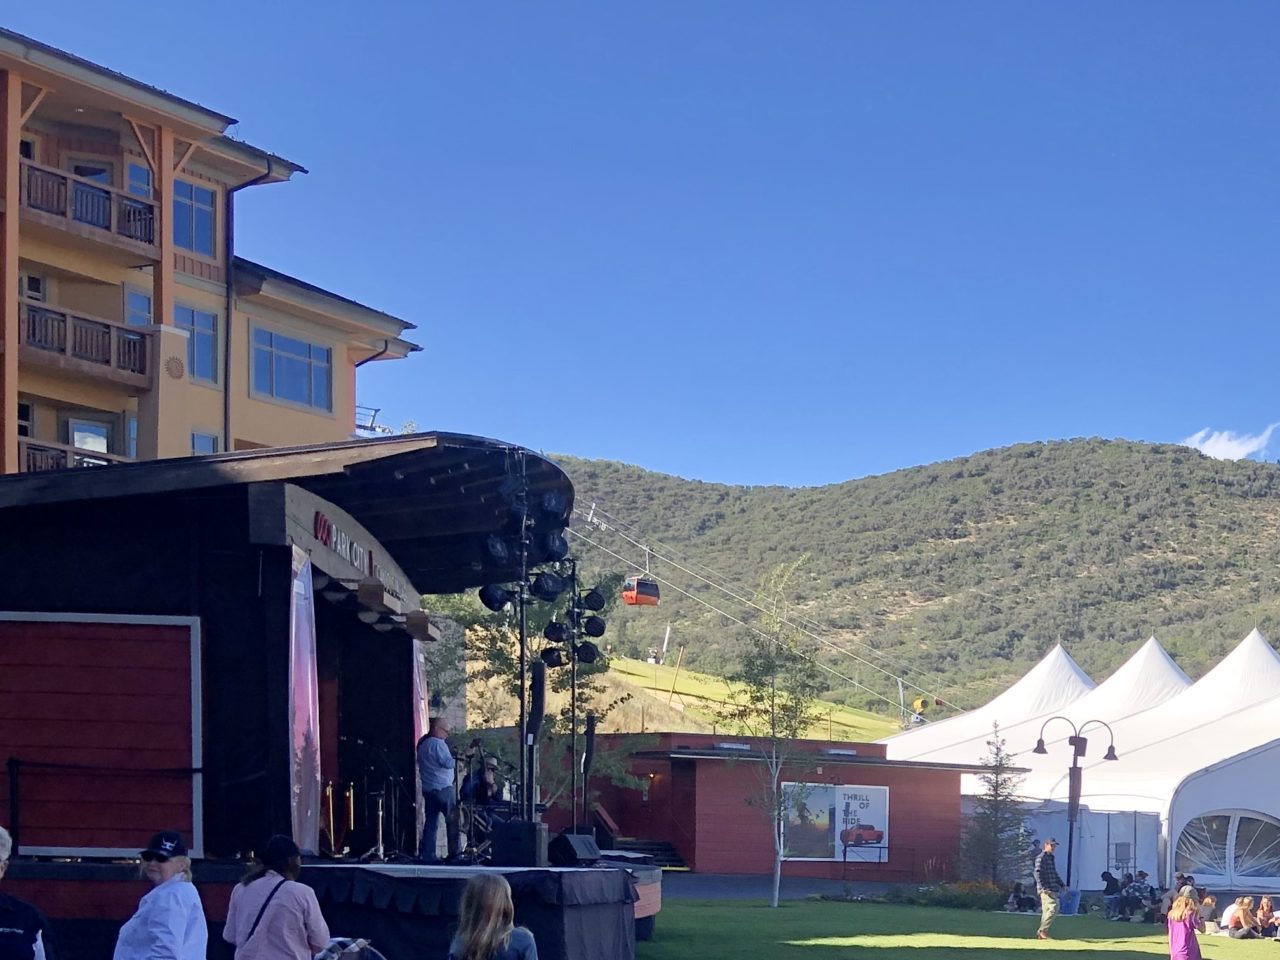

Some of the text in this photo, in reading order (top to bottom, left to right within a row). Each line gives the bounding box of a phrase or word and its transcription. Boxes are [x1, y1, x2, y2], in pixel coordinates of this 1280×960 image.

[331, 524, 368, 576] PARK CITY
[842, 793, 870, 802] THRILL
[859, 802, 870, 810] OF
[842, 817, 861, 825] RIDE
